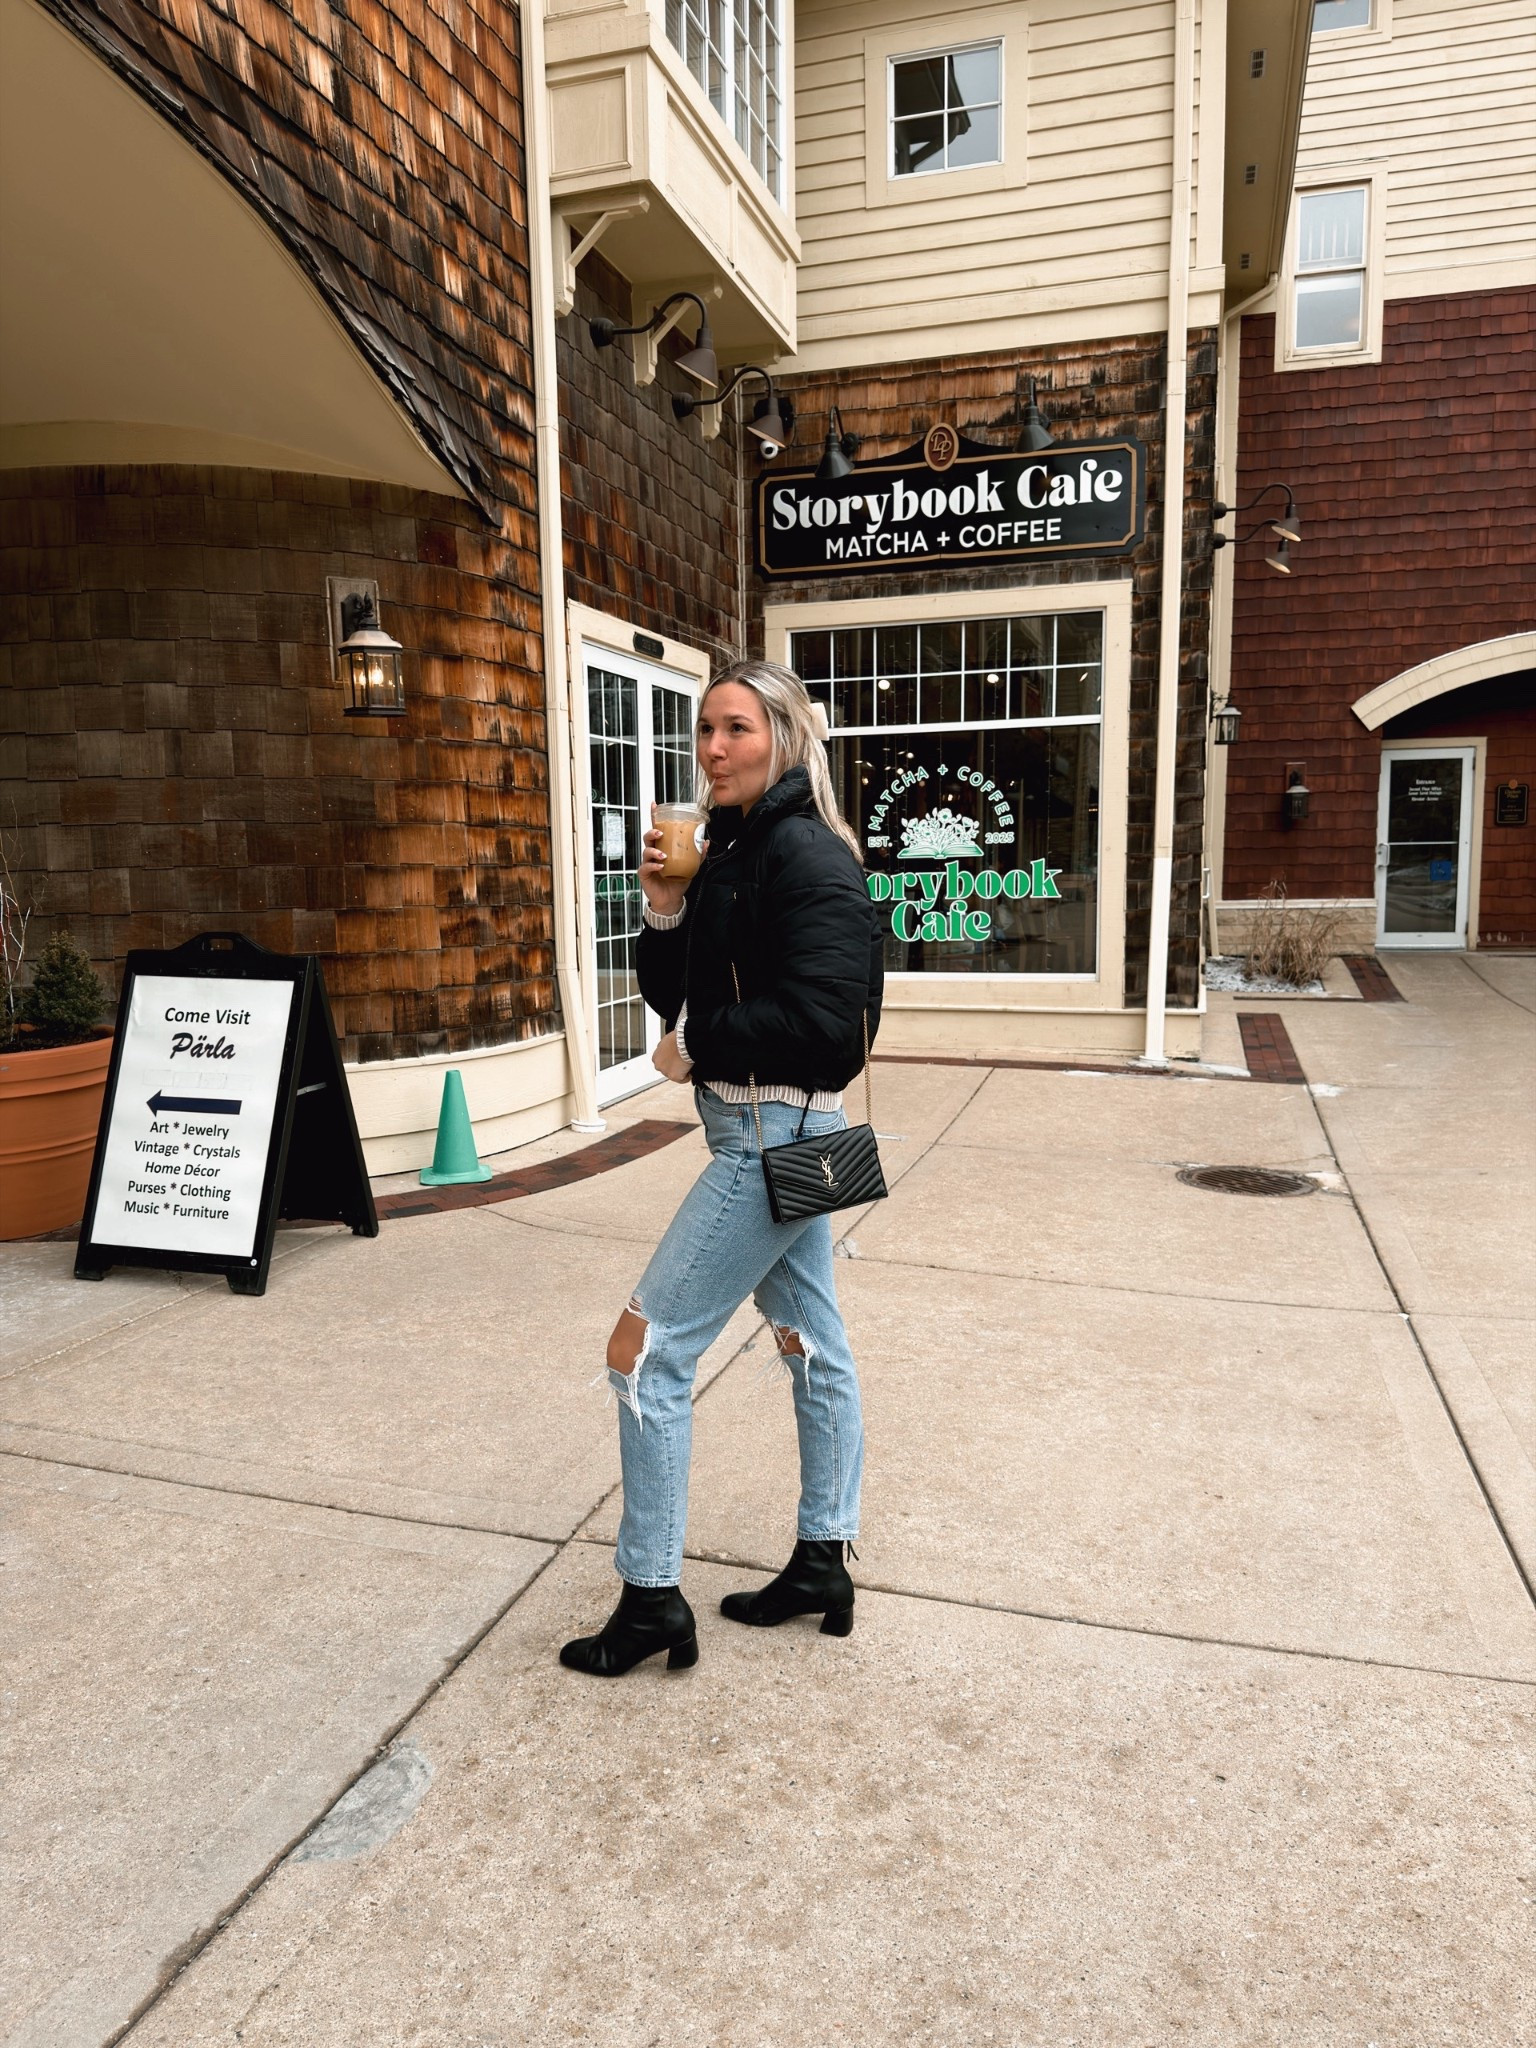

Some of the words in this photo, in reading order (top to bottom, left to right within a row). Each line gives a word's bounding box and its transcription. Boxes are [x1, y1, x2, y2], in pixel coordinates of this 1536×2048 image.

[772, 470, 1005, 534] Storybook
[1017, 459, 1123, 510] Cafe
[825, 531, 928, 560] MATCHA
[937, 533, 950, 547] +
[959, 518, 1062, 548] COFFEE
[868, 766, 929, 831] MATCHA
[957, 766, 1014, 827] COFFEE
[868, 836, 893, 848] EST.
[985, 831, 1015, 844] 2025
[867, 858, 1063, 911] orybook
[891, 900, 991, 942] Cafe
[165, 1007, 210, 1024] Come
[215, 1009, 251, 1025] Visit
[170, 1032, 236, 1060] Pärla
[150, 1121, 169, 1134] Art
[182, 1123, 230, 1140] Jewelry
[134, 1140, 180, 1157] Vintage
[193, 1144, 241, 1159] Crystals
[145, 1161, 181, 1175] Home
[184, 1164, 221, 1177] Décor
[819, 1153, 839, 1187] YSL
[128, 1180, 166, 1194] Purses
[180, 1184, 231, 1202] Clothing
[124, 1201, 160, 1214] Music
[173, 1204, 229, 1220] Furniture
